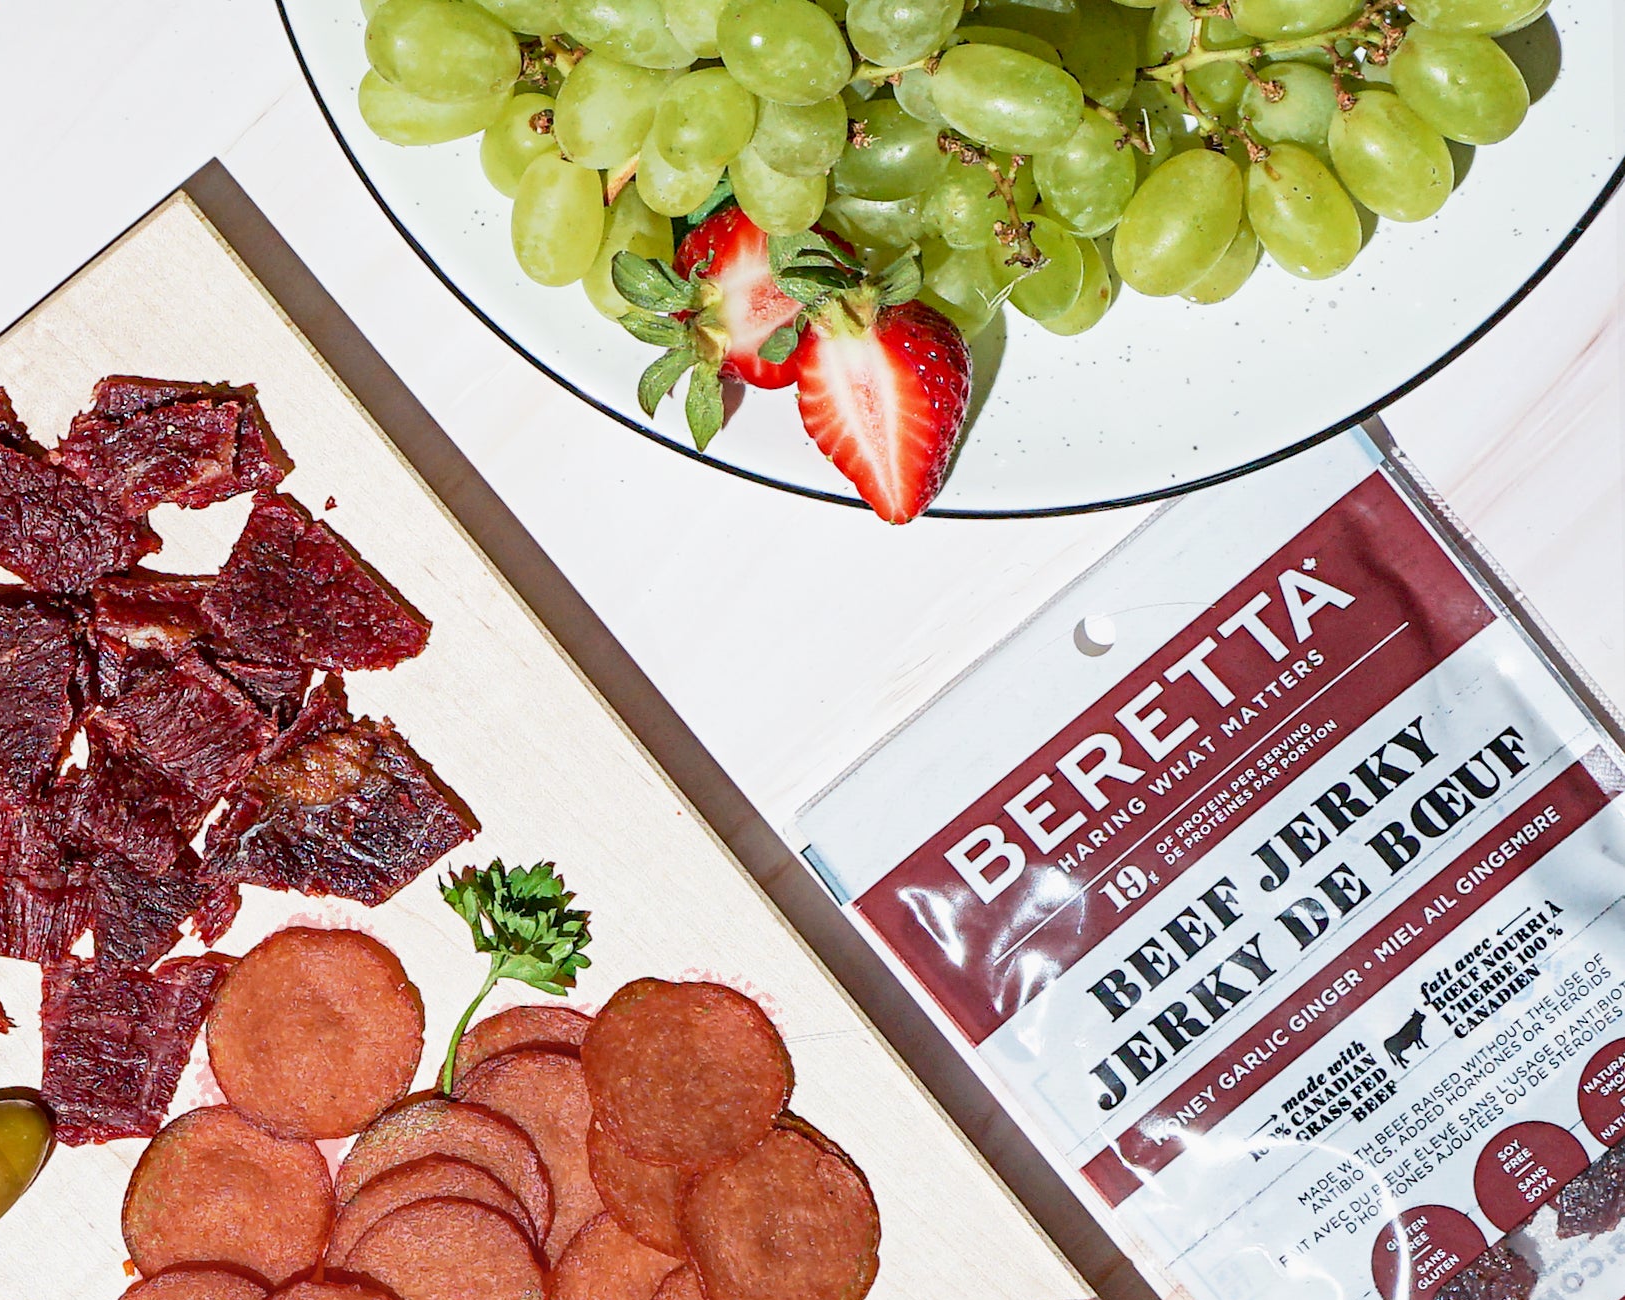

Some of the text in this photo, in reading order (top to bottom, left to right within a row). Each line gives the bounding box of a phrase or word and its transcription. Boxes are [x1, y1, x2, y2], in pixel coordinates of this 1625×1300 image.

[943, 547, 1356, 906] BERETTA
[1148, 733, 1219, 799] WHAT
[1220, 646, 1325, 738] MATTERS
[1153, 720, 1313, 855] OF PROTEIN PER SERVING
[1163, 844, 1185, 866] DE
[1250, 763, 1281, 792] PAR
[1278, 717, 1338, 770] PORTION
[1086, 715, 1447, 1023] BEEF JERKY
[1079, 724, 1538, 1113] JERKY DE BŒUF
[1215, 1025, 1291, 1093] GARLIC
[1285, 964, 1365, 1035] GINGER
[1372, 915, 1424, 964] MIEL
[1419, 887, 1460, 926] AIL
[1453, 804, 1562, 898] GINGEMBRE
[1416, 936, 1493, 1005] fait avec
[1430, 965, 1483, 1012] BŒUF
[1479, 911, 1549, 972] NOURRI
[1440, 959, 1518, 1026] L'HERBE
[1514, 933, 1550, 966] 100
[1450, 962, 1541, 1041] CANADIEN
[1278, 1037, 1367, 1114] made with
[1289, 1052, 1378, 1128] CANADIAN
[1293, 1065, 1389, 1146] GRASS FED
[1297, 952, 1606, 1206] MADE WTH BEEF RAISED WITHOUT THE USE OF
[1309, 966, 1613, 1214] ANTIBIOICS, ADDED HORMONES OR STEROIDS
[1350, 1078, 1400, 1123] BEEF
[1582, 1052, 1625, 1095] NATURA
[1311, 1208, 1349, 1243] AVEC
[1349, 1192, 1370, 1213] DU
[1412, 1120, 1458, 1162] ÉLEVÉ
[1457, 1091, 1496, 1126] SANS
[1496, 1044, 1555, 1095] L'USAGE
[1432, 1102, 1505, 1164] AJOUTÉES
[1504, 1084, 1527, 1106] OU
[1527, 1066, 1549, 1087] DE
[1496, 1138, 1522, 1162] SOY
[1502, 1147, 1532, 1174] FREE
[1516, 1164, 1548, 1193] SANS
[1524, 1174, 1558, 1204] SOYA
[1384, 1214, 1429, 1253] GLTEN
[1403, 1230, 1430, 1255] REE
[1415, 1247, 1447, 1275] SANS
[1416, 1253, 1460, 1291] GLUTEN
